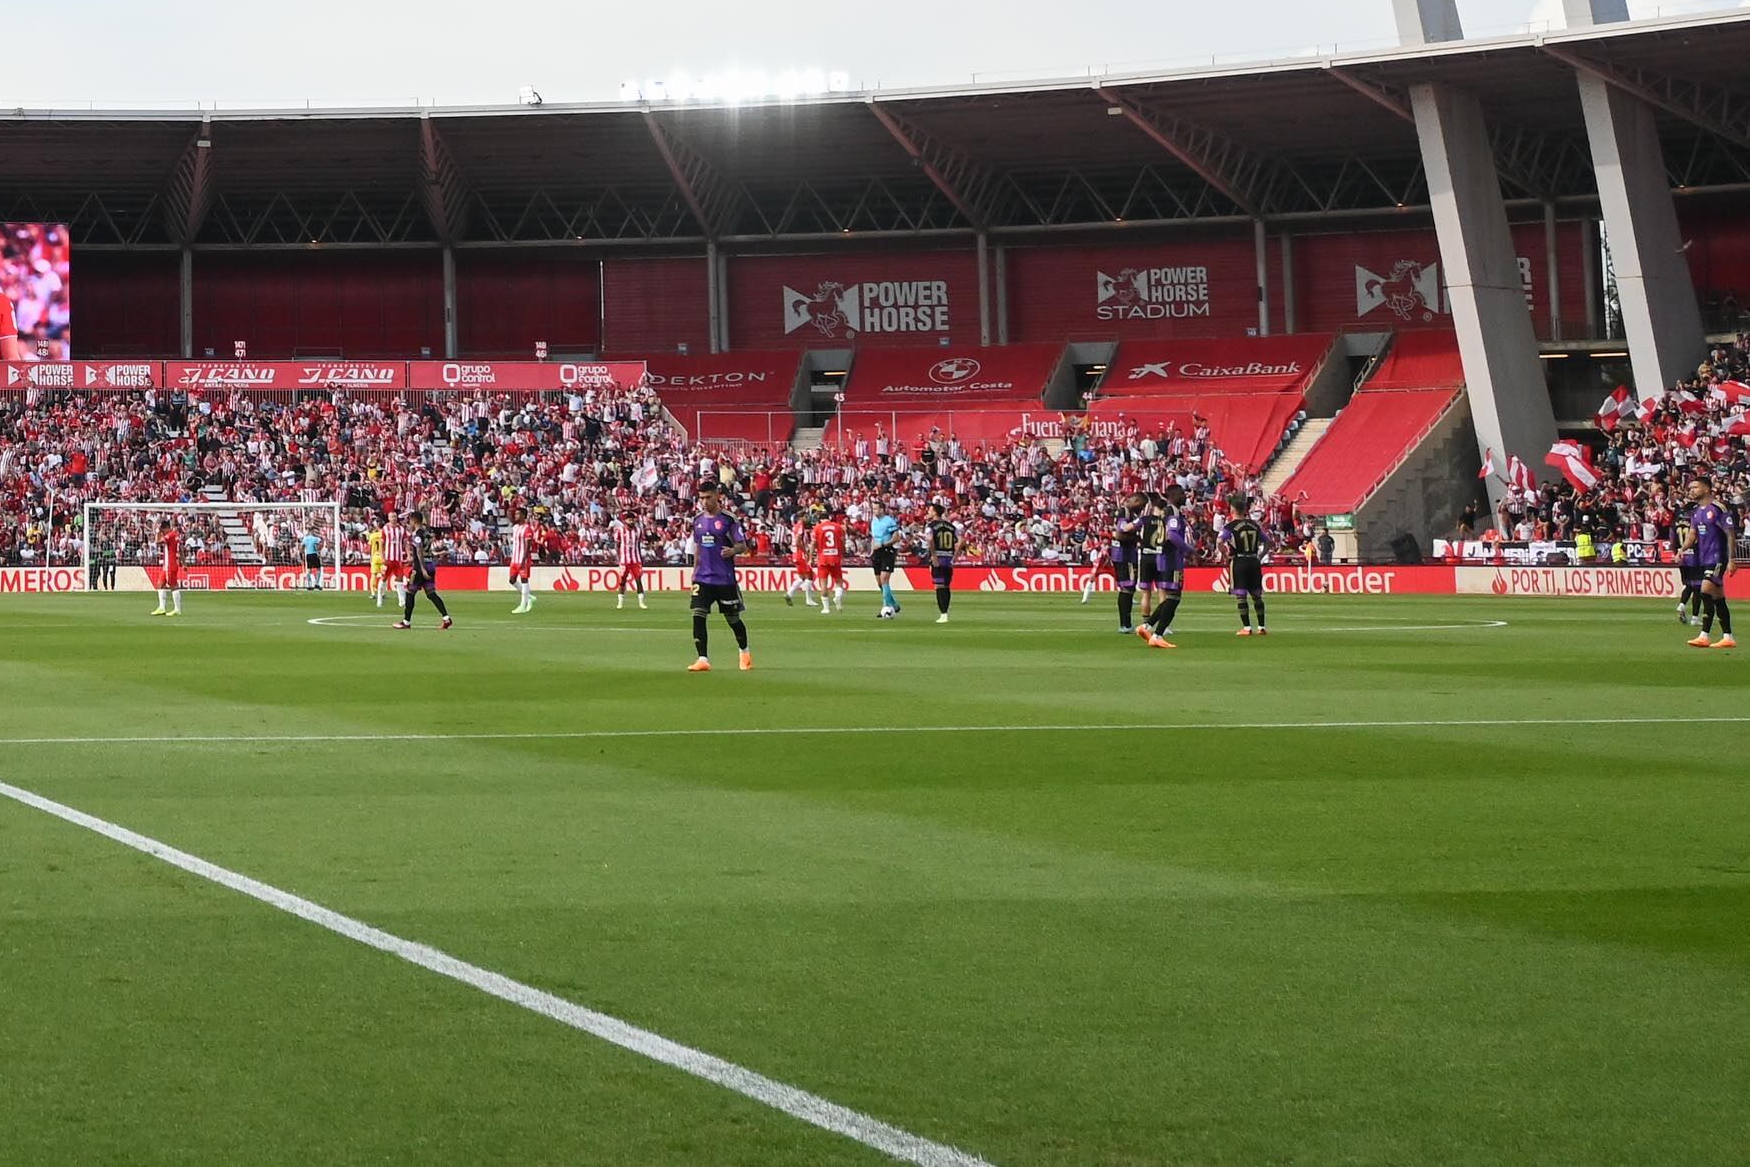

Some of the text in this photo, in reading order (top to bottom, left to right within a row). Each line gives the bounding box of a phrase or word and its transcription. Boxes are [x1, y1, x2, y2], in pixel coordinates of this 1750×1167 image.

[1150, 266, 1207, 285] POWER
[862, 281, 948, 307] POWER
[1151, 284, 1209, 303] HORSE
[864, 306, 950, 333] HORSE
[1097, 302, 1210, 321] STADIUM
[39, 364, 74, 375] POWER
[116, 364, 151, 375] POWER
[460, 365, 491, 375] grupo
[577, 366, 608, 375] grupo
[1179, 362, 1301, 376] CaixaBank
[39, 375, 74, 386] HORSE
[460, 373, 496, 383] control
[578, 373, 612, 384] control
[649, 372, 766, 386] DEKTON
[834, 393, 845, 402] 45
[825, 531, 835, 548] 3
[937, 531, 953, 550] 10
[1240, 530, 1257, 552] 17
[1012, 567, 1115, 592] Santan
[1262, 566, 1395, 594] antander
[1511, 569, 1540, 593] POR
[1563, 570, 1592, 594] LOS
[1596, 570, 1674, 596] PRIMEROS
